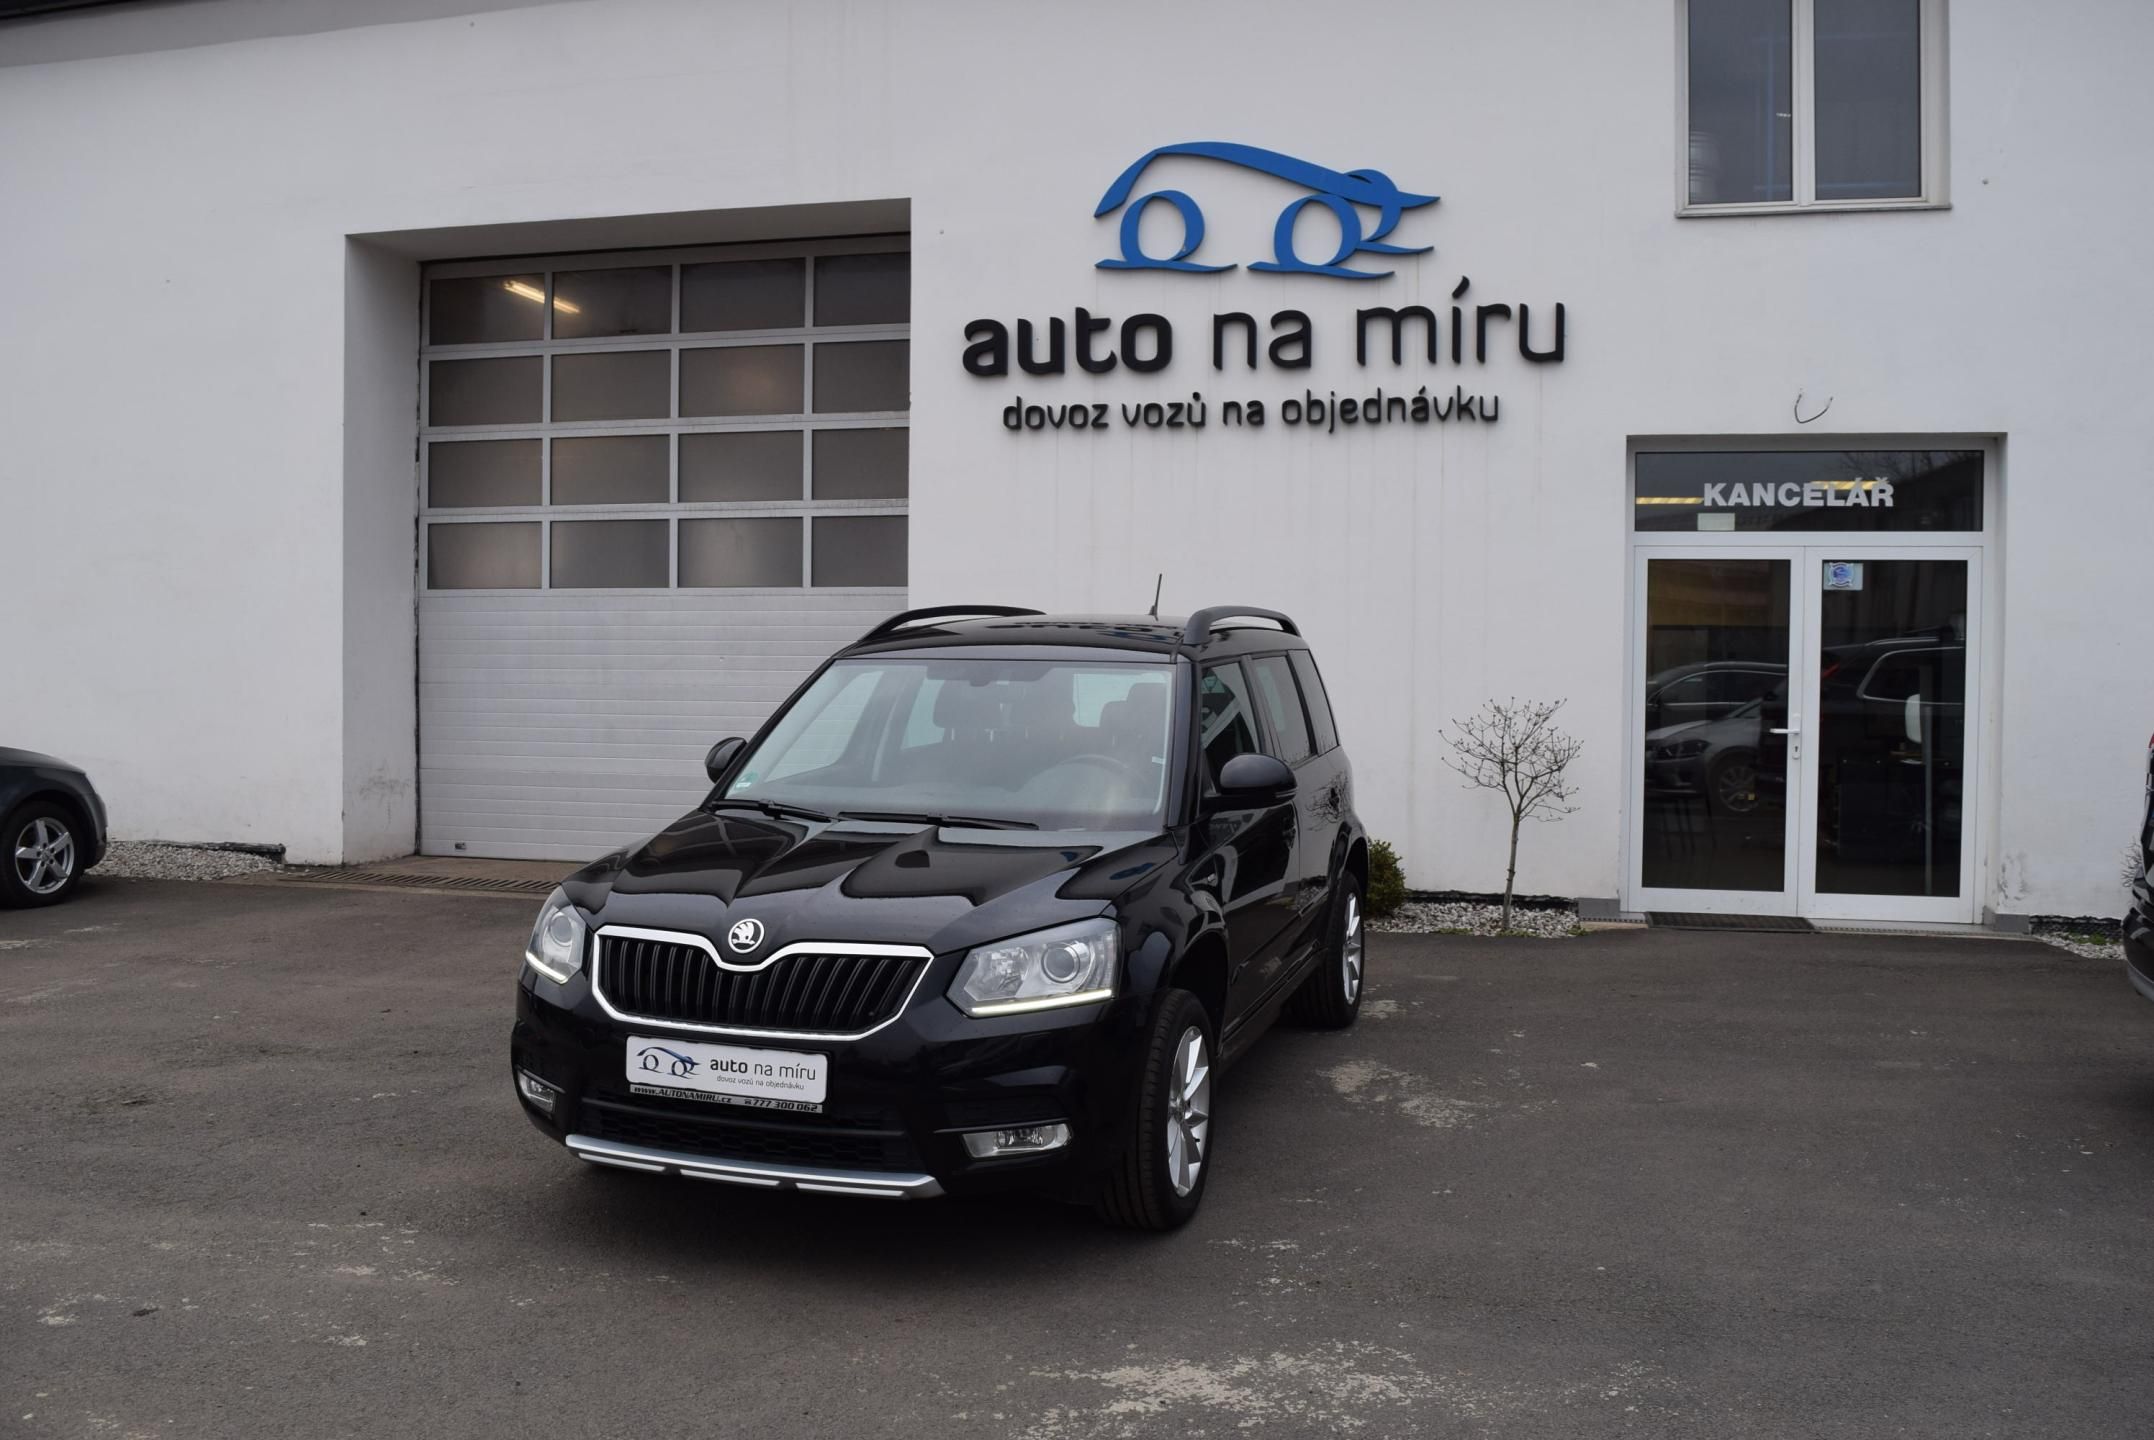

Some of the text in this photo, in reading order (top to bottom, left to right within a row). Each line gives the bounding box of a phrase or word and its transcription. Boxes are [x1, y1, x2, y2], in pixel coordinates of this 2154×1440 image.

[962, 276, 1566, 376] auto na míru
[1003, 385, 1499, 433] dovoz vozů na objednávku
[1703, 477, 1894, 507] KANCELÁŘ
[710, 1059, 816, 1081] auto na míru
[716, 1075, 736, 1084] dovoz
[753, 1099, 772, 1108] 777
[775, 1101, 795, 1110] 300
[796, 1103, 818, 1112] 062
